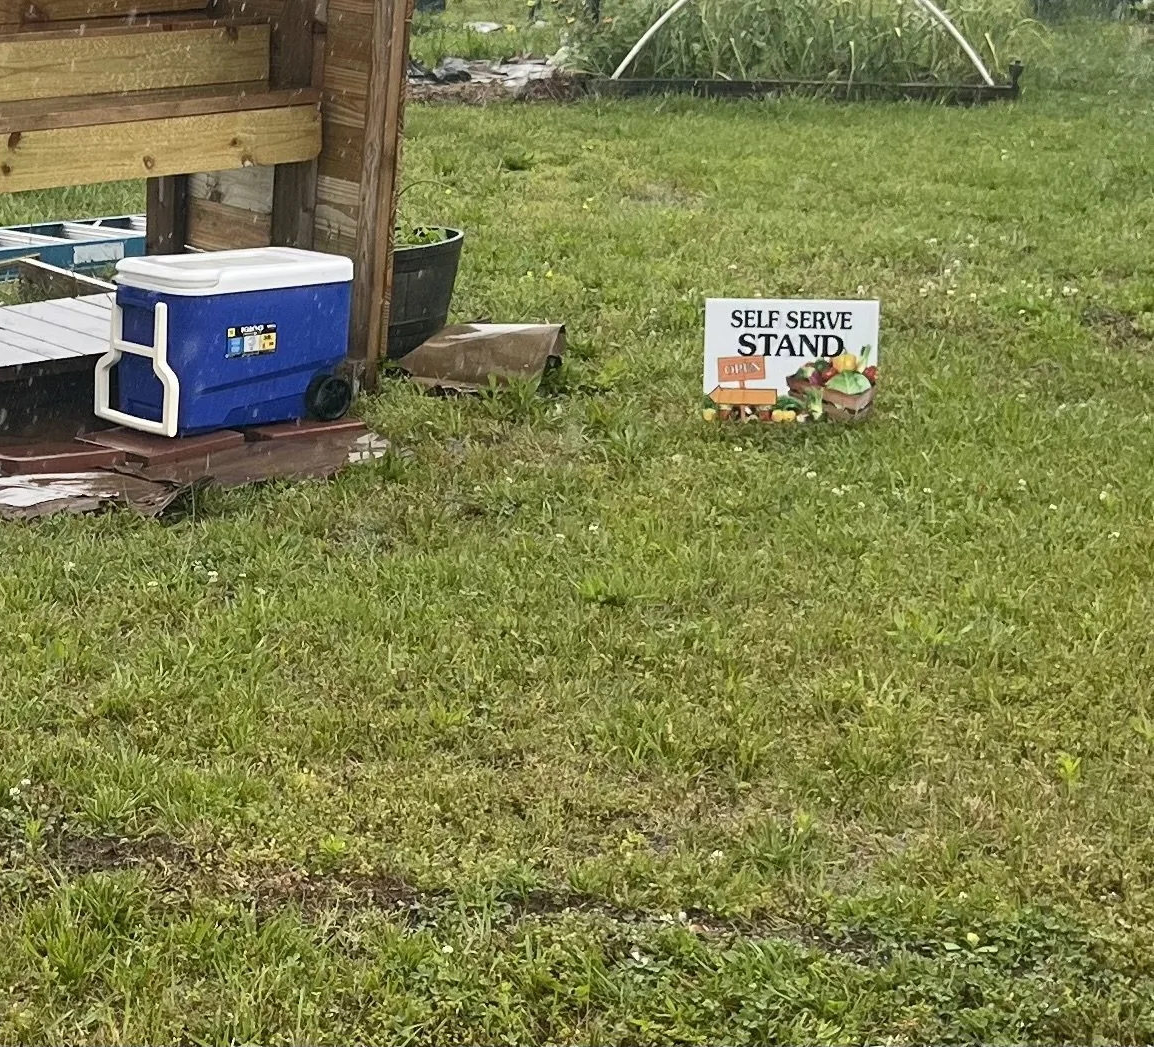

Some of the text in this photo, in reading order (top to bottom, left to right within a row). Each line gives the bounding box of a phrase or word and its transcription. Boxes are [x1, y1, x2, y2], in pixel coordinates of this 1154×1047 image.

[730, 309, 853, 330] SELF SERVE
[737, 333, 845, 358] STAND
